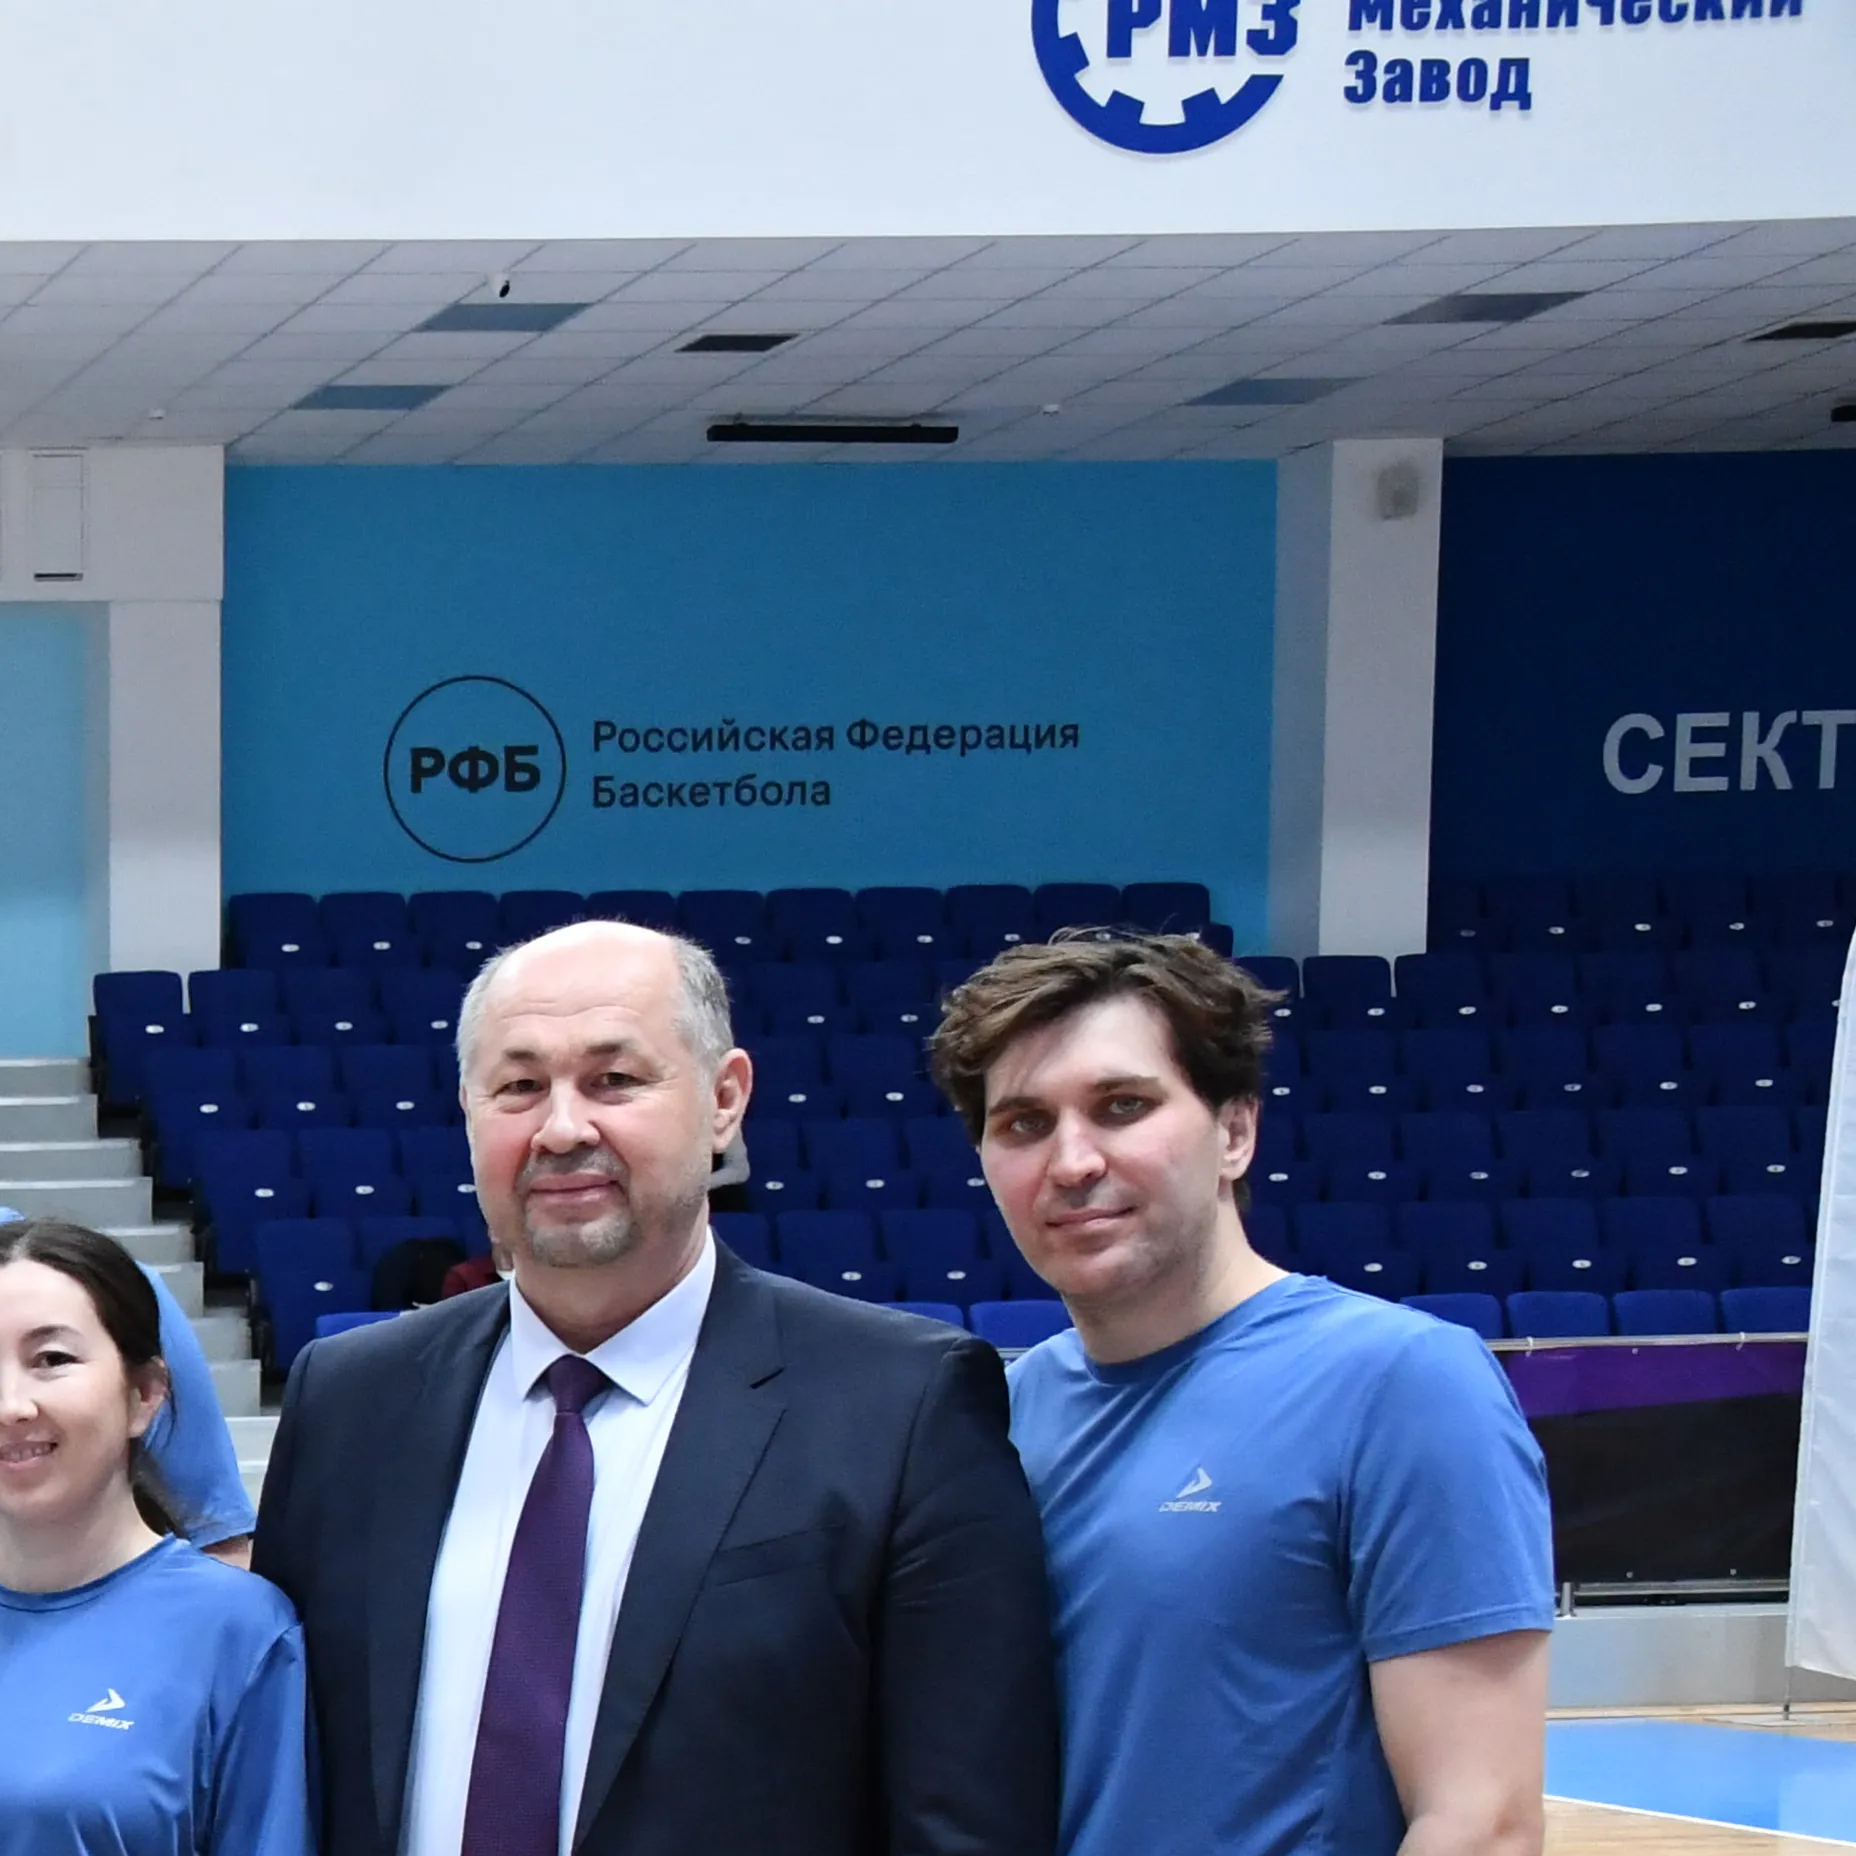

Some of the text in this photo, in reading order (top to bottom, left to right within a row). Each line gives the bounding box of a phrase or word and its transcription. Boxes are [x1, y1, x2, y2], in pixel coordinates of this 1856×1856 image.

[1106, 0, 1301, 58] РМЗ
[1343, 49, 1533, 111] Завод
[592, 716, 1081, 757] Российская Федерация
[1603, 709, 1856, 795] СЕКТ
[409, 744, 542, 794] РФБ
[592, 774, 833, 810] Баскетбола
[1158, 1501, 1222, 1513] DEMIX
[67, 1712, 135, 1730] DEMIX
